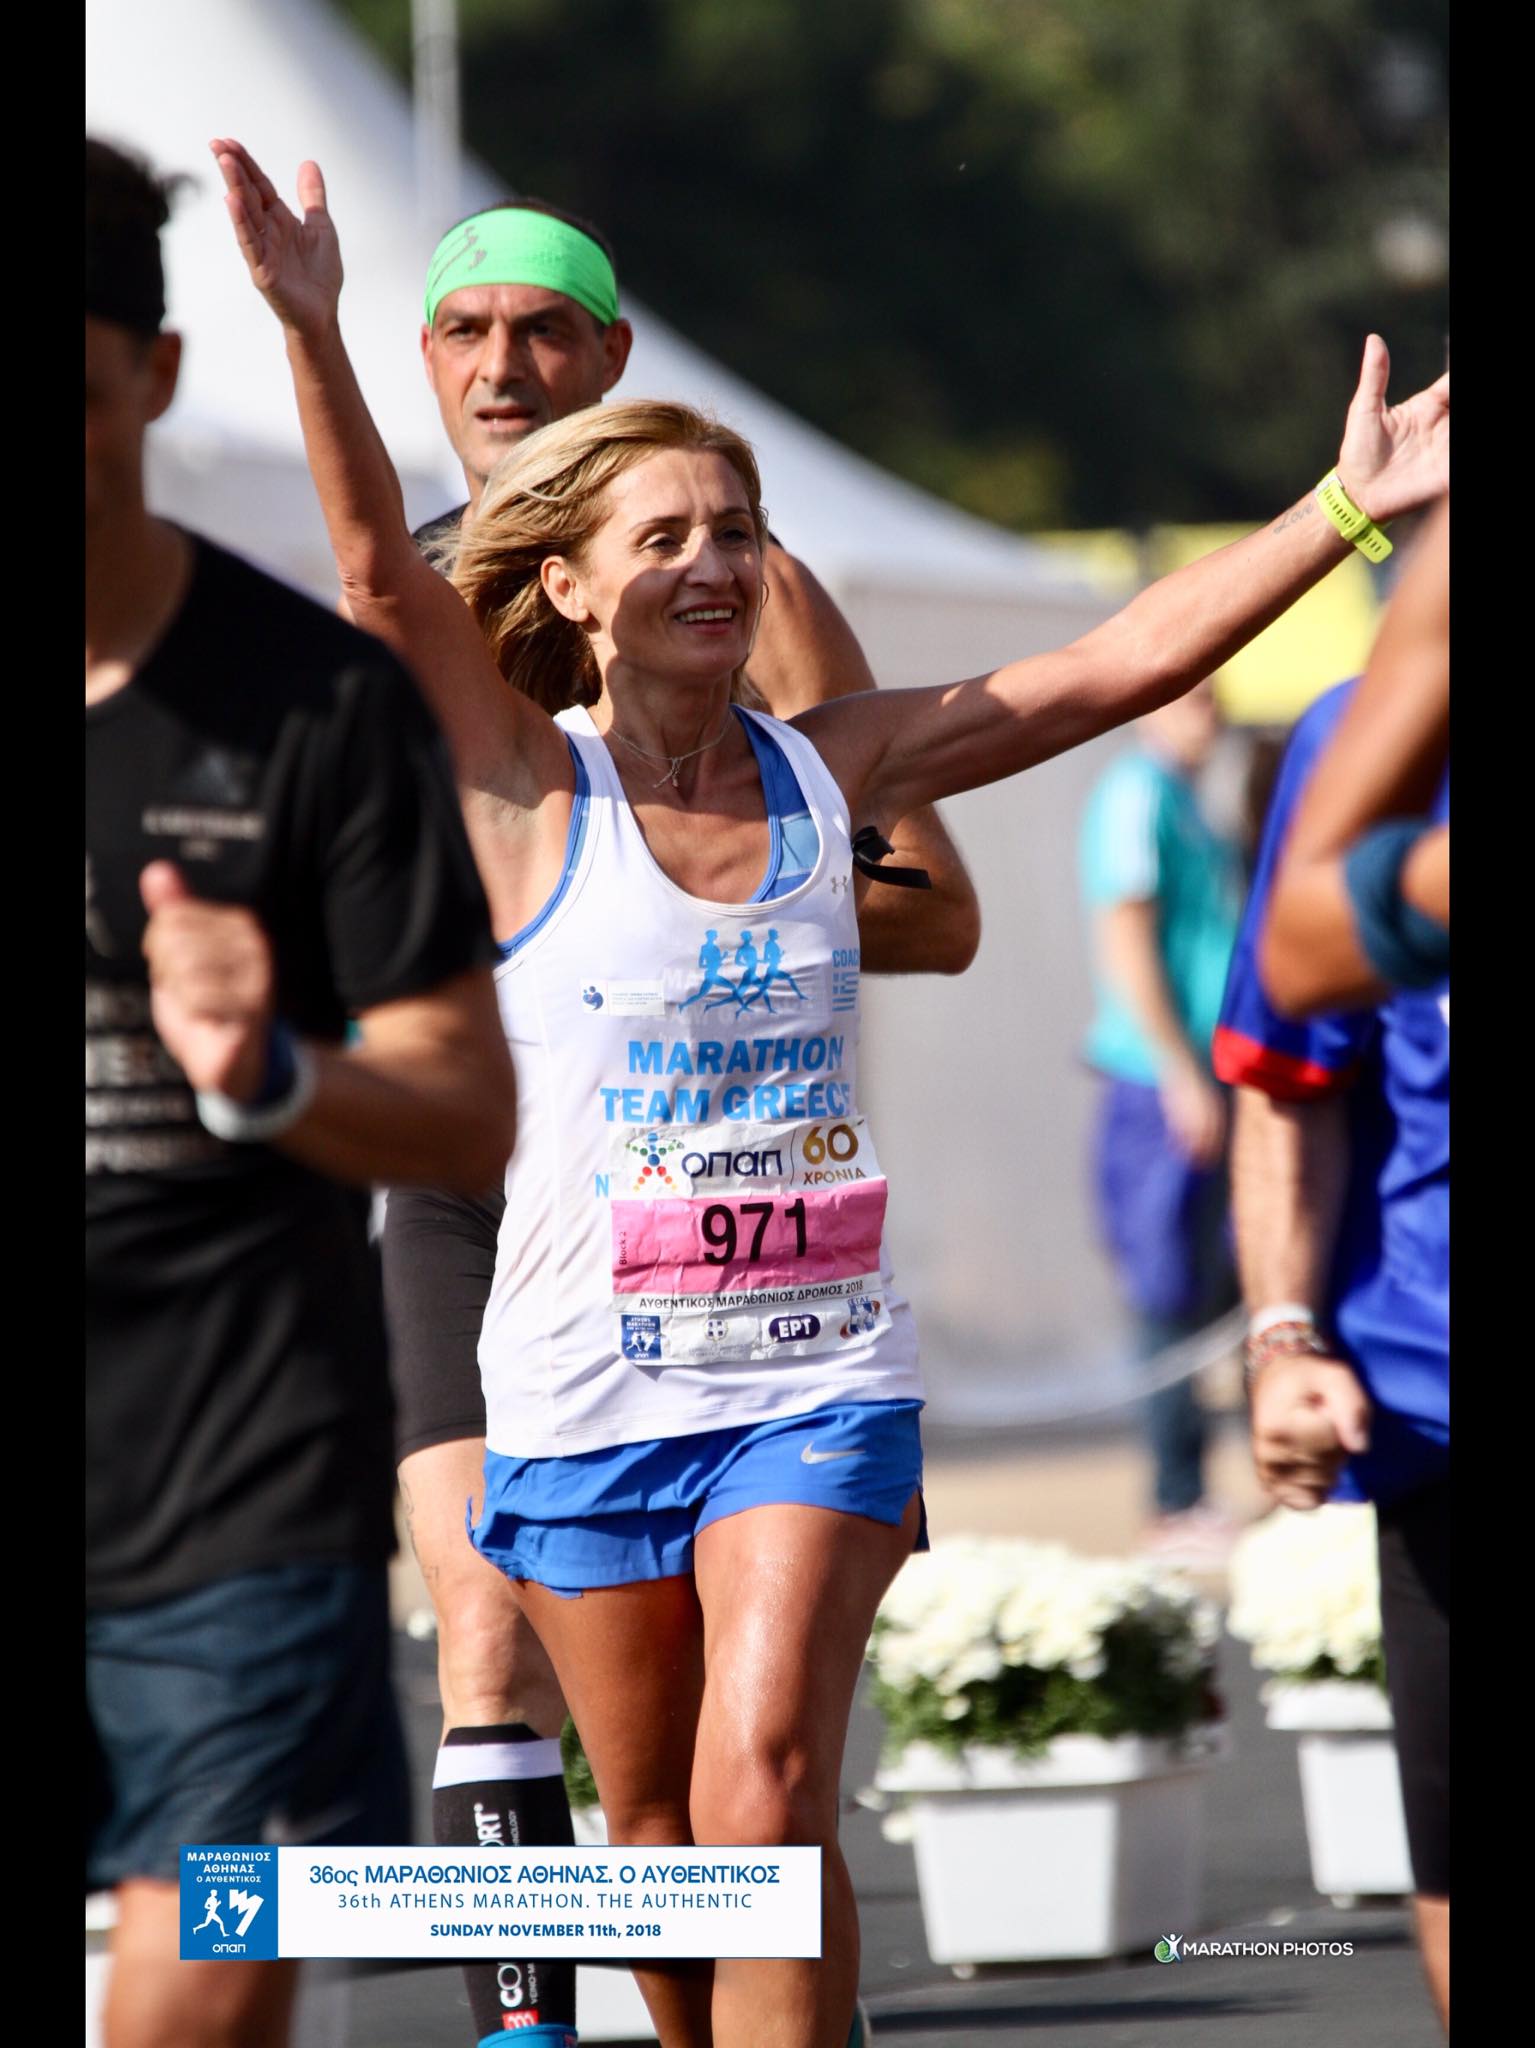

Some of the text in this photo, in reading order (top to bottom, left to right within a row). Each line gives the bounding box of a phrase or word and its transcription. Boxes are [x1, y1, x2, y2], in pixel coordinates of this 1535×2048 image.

[628, 1036, 844, 1075] MARATHON
[600, 1087, 711, 1122] TEAM
[802, 1124, 859, 1165] 60
[803, 1167, 867, 1185] ΧΡΟΝΙΑ
[701, 1197, 807, 1265] 971
[619, 1239, 627, 1264] Block
[639, 1298, 714, 1309] ΑΥΘΕΝΤΙΚΟΣ
[716, 1291, 796, 1308] ΜΑΡΑΘΩΝΙΟΣ
[797, 1284, 843, 1301] ΔΡΟΜΟΣ
